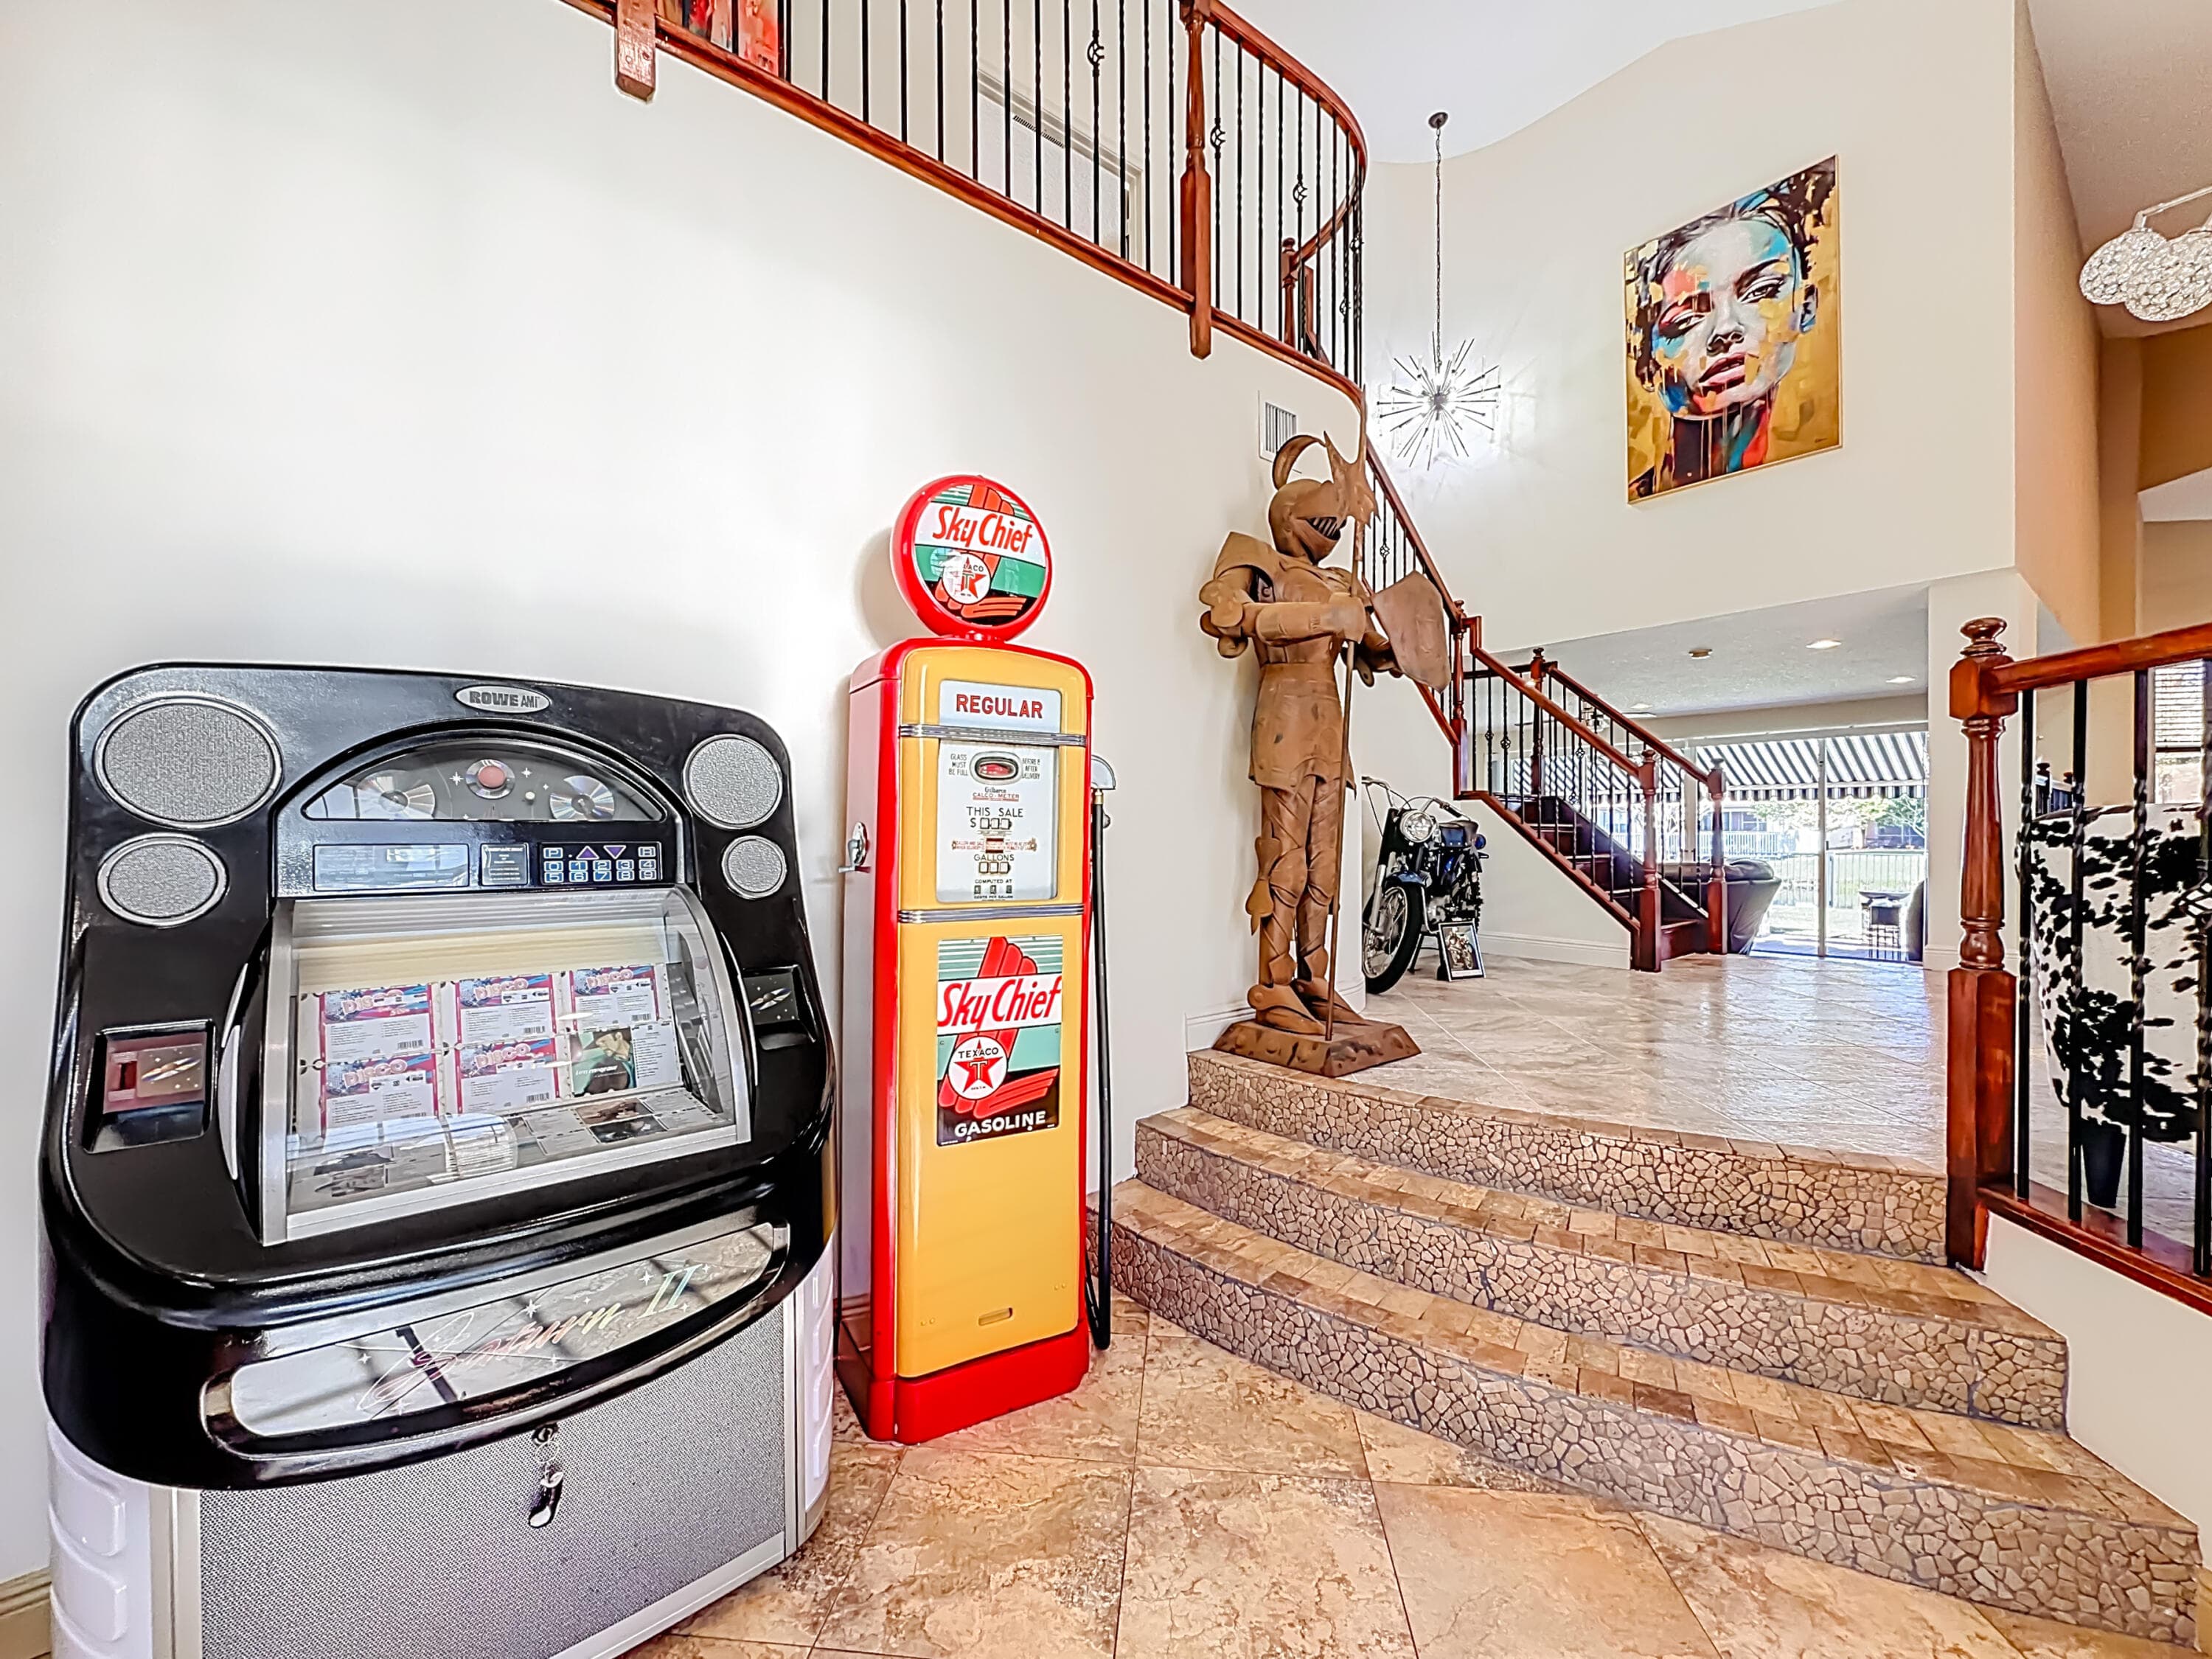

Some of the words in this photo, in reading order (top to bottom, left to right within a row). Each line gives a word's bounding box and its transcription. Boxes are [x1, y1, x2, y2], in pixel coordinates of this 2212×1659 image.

[932, 506, 977, 547] Sky
[978, 513, 1032, 554] Chief
[469, 691, 518, 706] ROWE
[956, 693, 1043, 719] REGULAR
[966, 806, 990, 816] THIS
[998, 807, 1023, 818] SALE
[937, 981, 992, 1031] Sky
[992, 975, 1062, 1022] Chief
[474, 1043, 531, 1069] DISCO
[959, 1047, 999, 1059] TEXACO
[343, 1059, 407, 1088] DISCO
[969, 1060, 988, 1080] T
[954, 1110, 1046, 1137] GASOLINE
